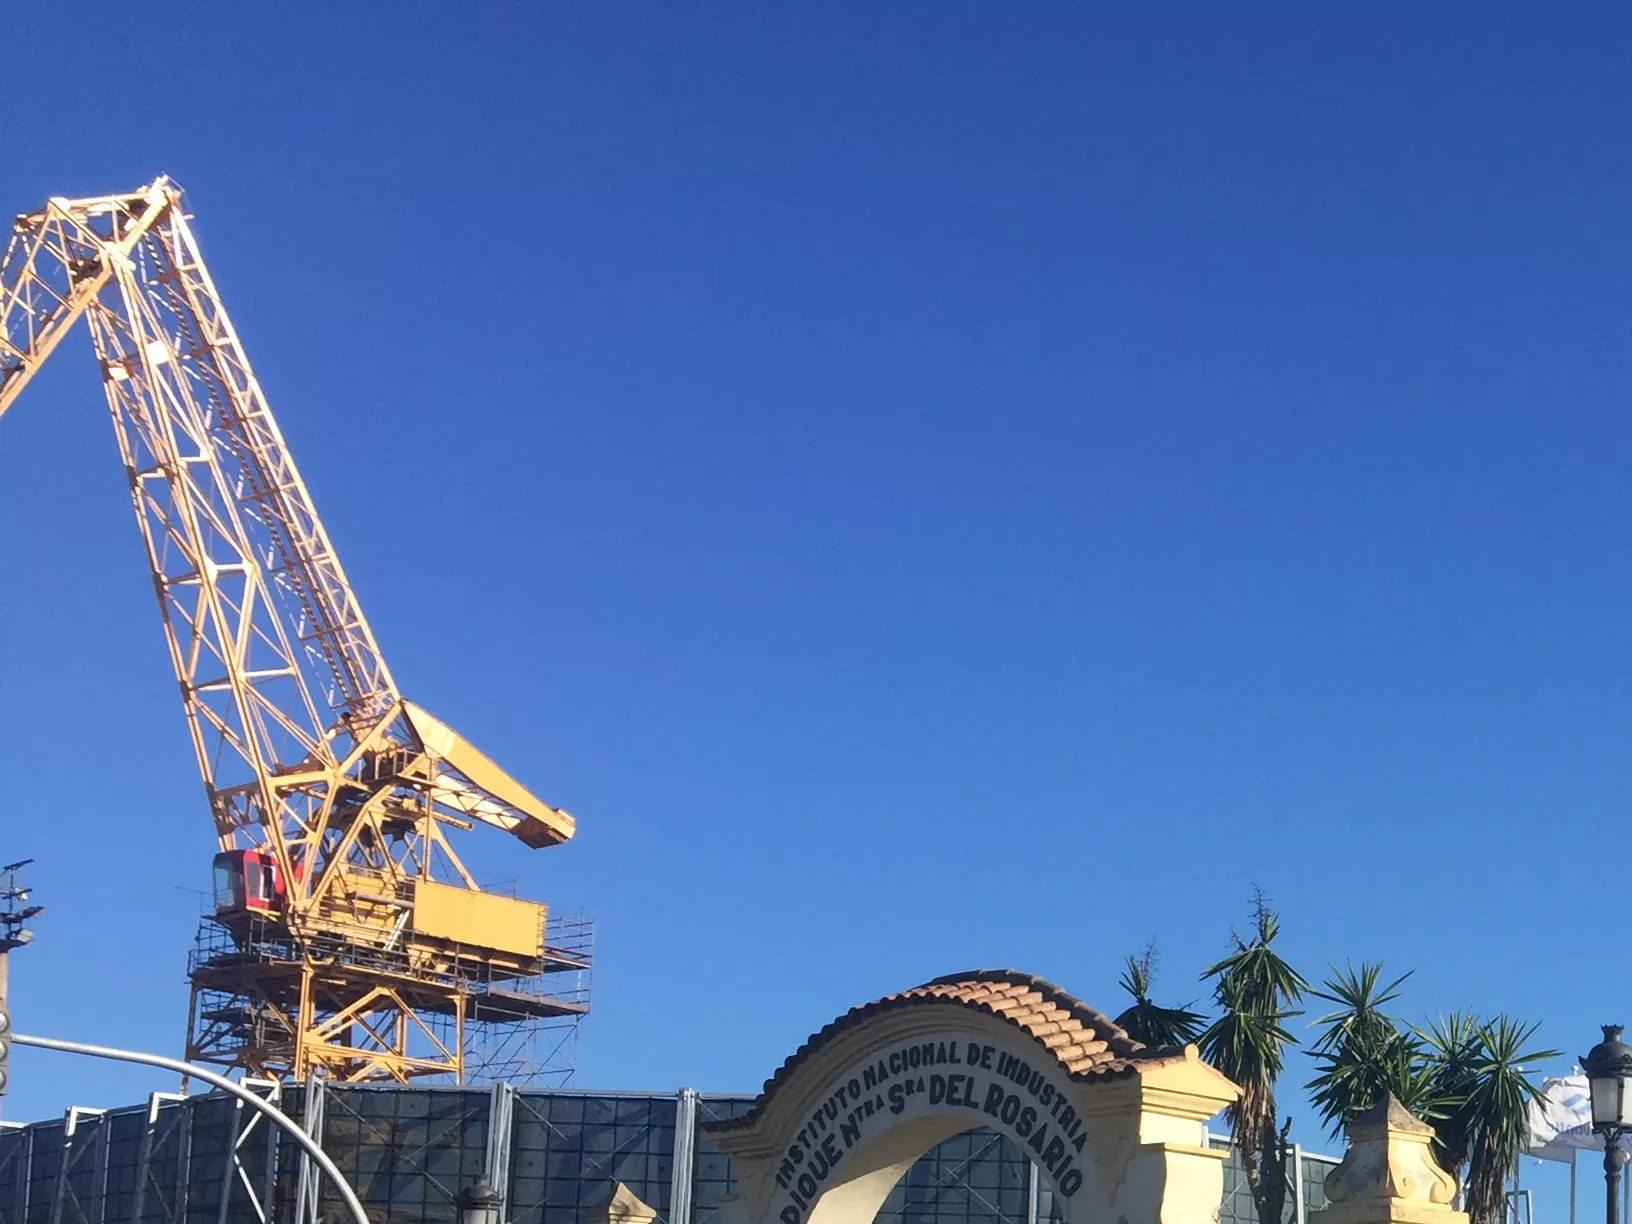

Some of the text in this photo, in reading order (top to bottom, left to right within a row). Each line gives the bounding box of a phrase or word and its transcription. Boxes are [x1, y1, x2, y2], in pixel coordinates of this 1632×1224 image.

[775, 1041, 1088, 1190] INSTITUTO NACIONAL DE INDUSTRIA
[929, 1074, 979, 1109] DEL
[983, 1083, 1082, 1198] ROSARIO
